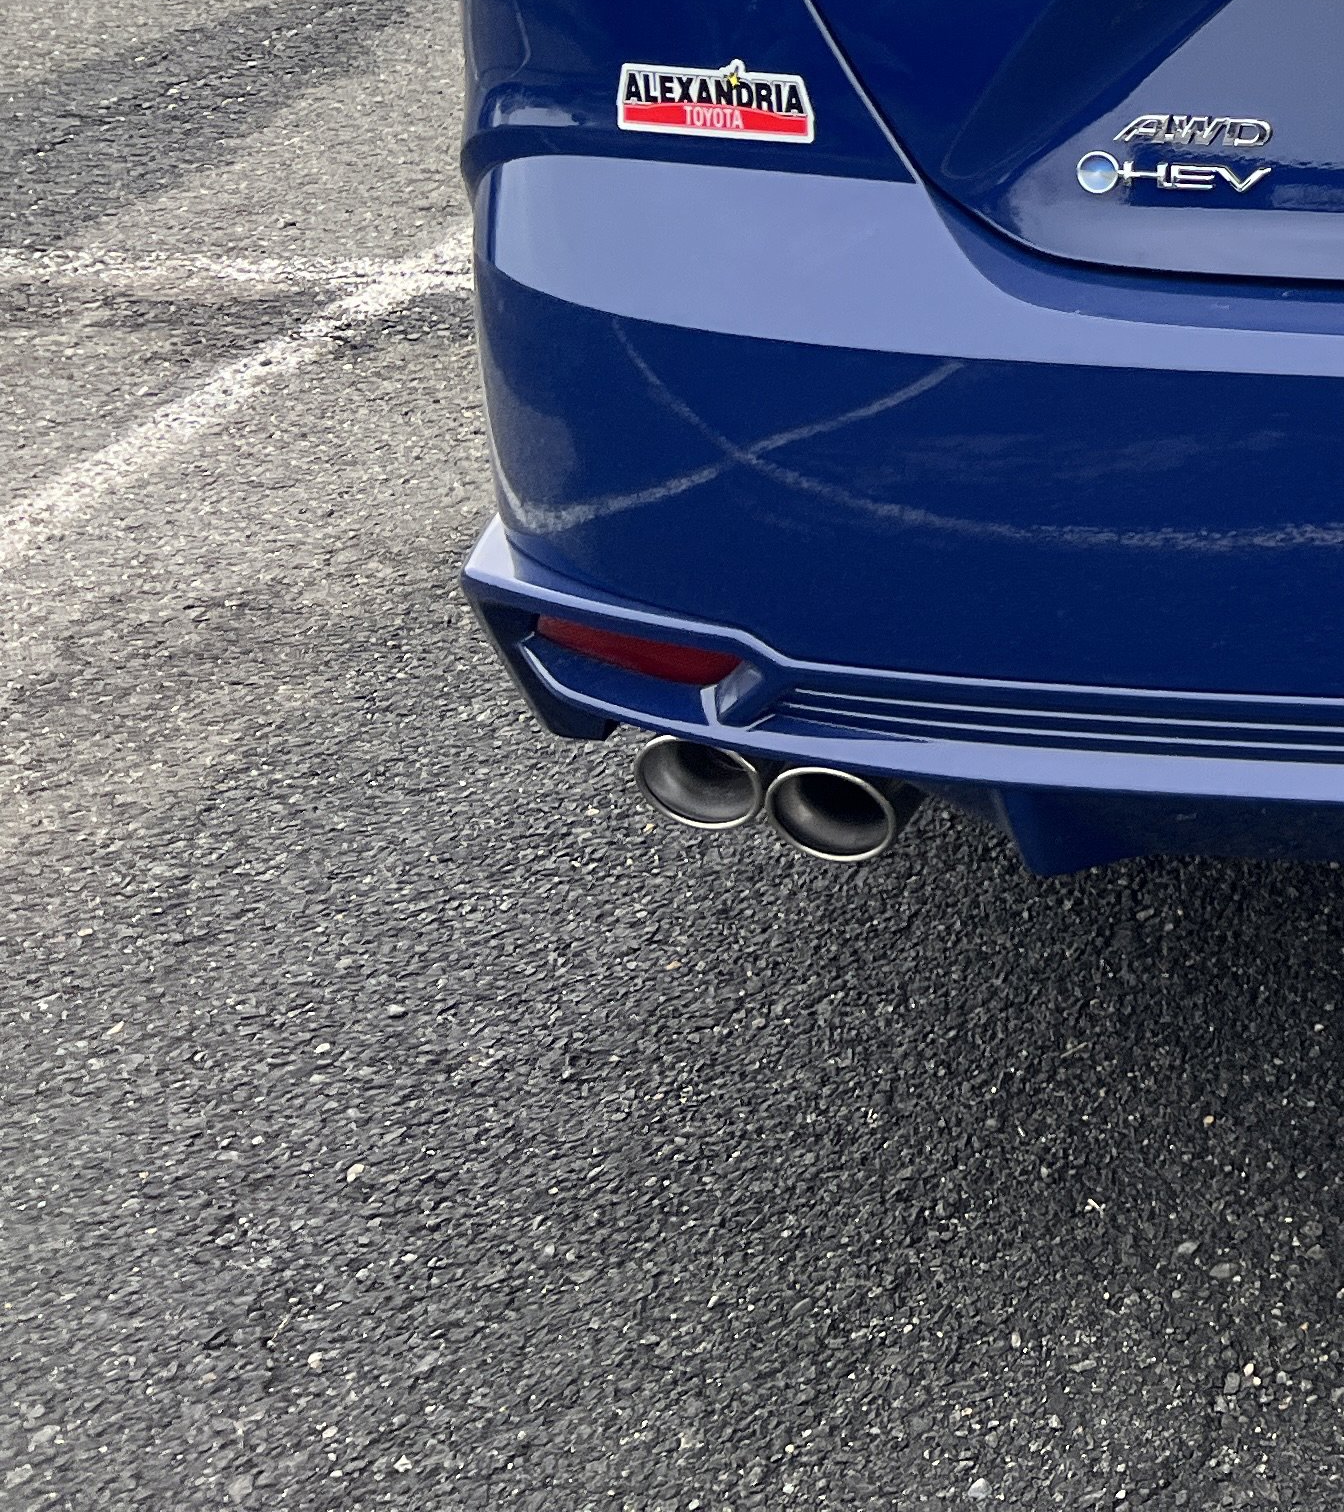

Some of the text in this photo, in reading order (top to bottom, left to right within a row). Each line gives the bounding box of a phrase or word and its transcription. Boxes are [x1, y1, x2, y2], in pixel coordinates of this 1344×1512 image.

[624, 71, 805, 115] ALEXANDRIA
[683, 104, 745, 130] TOYOTA
[1113, 114, 1272, 146] AWD
